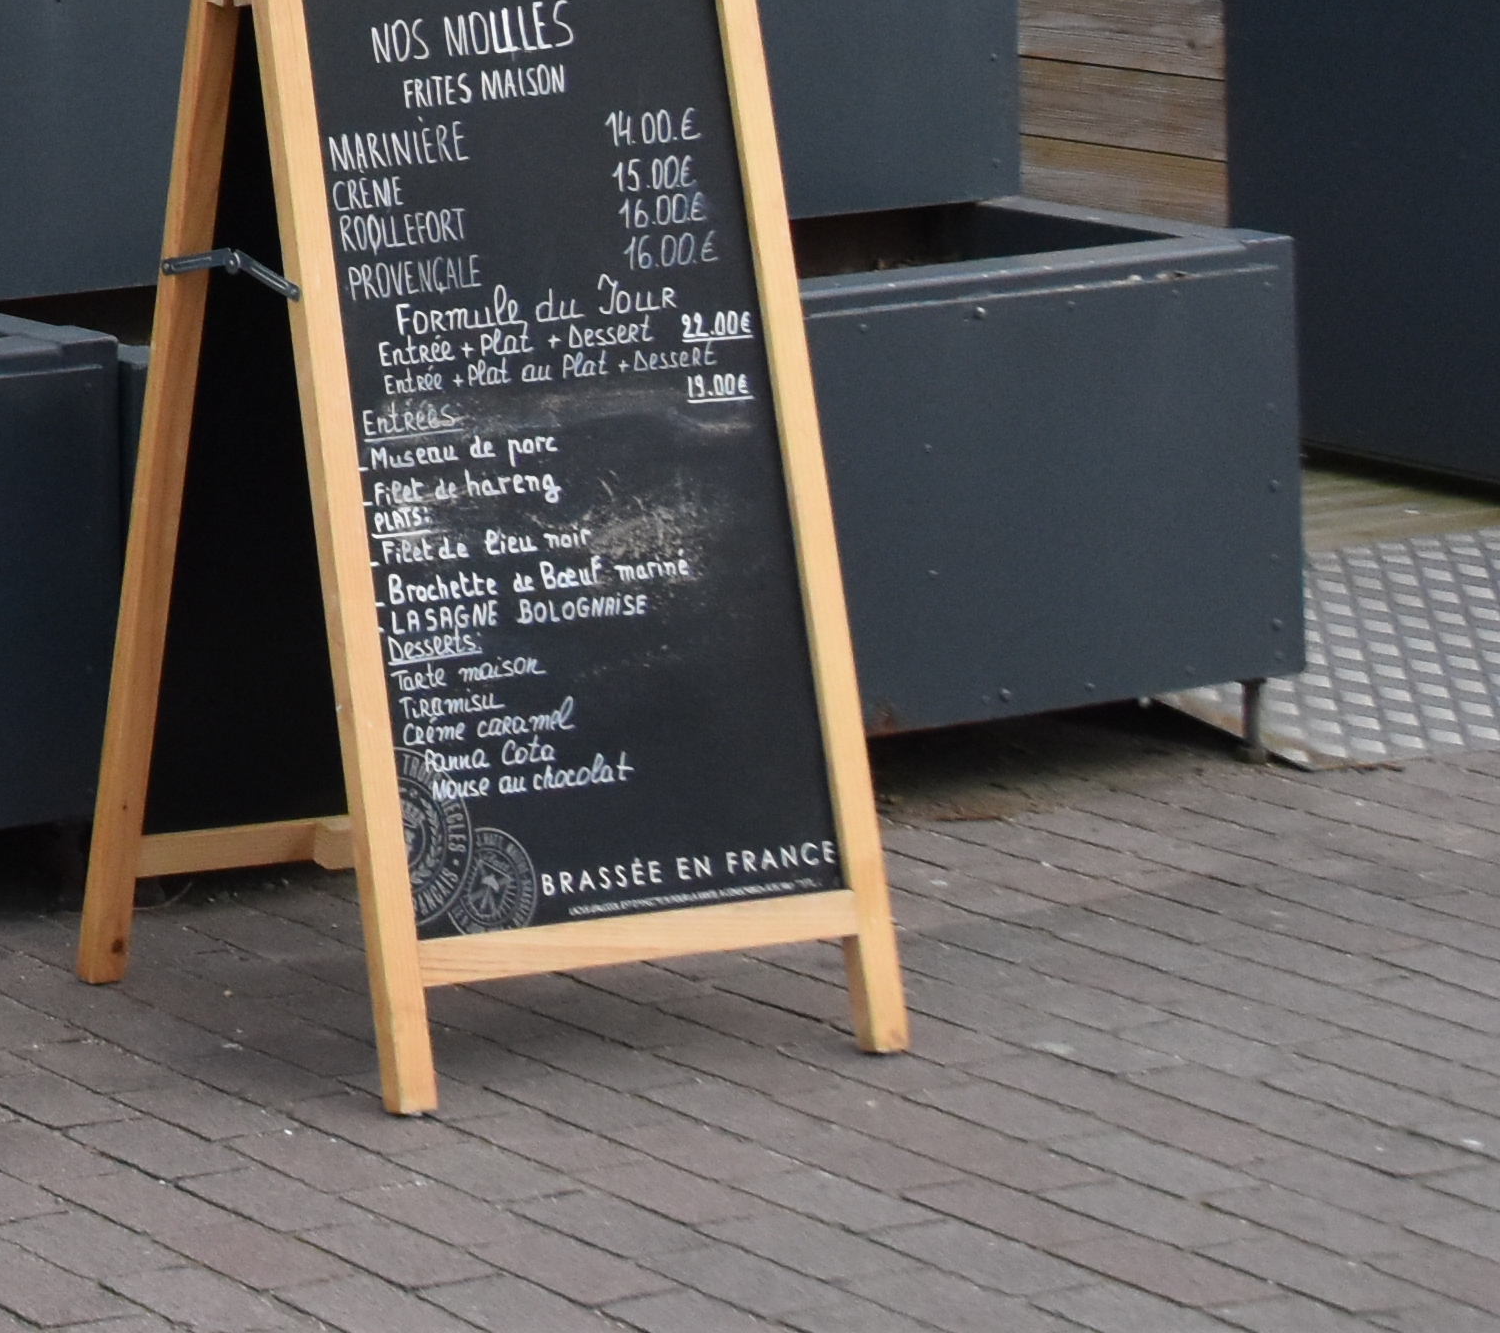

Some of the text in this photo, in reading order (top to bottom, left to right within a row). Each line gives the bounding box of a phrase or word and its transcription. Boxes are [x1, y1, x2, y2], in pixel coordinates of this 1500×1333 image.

[371, 18, 429, 63] NOS
[403, 64, 565, 108] FRITES MAISON
[328, 115, 470, 171] MARINIÈRE
[332, 170, 404, 211] CRÈME
[339, 208, 465, 255] ROQUEFORT
[347, 254, 482, 301] PROVENÇALE
[535, 288, 585, 322] du
[562, 349, 609, 379] Plat
[469, 435, 496, 459] de
[508, 436, 558, 467] porc
[435, 478, 458, 500] de
[464, 468, 562, 503] hareng
[439, 536, 470, 560] de
[543, 528, 592, 549] noir
[513, 572, 535, 593] de
[613, 548, 690, 582] mariné
[458, 656, 546, 682] maison
[423, 734, 555, 773] Panna Cota
[498, 774, 527, 795] au
[532, 751, 634, 791] chocolat
[541, 840, 837, 896] BRASSÉE EN FRANCE
